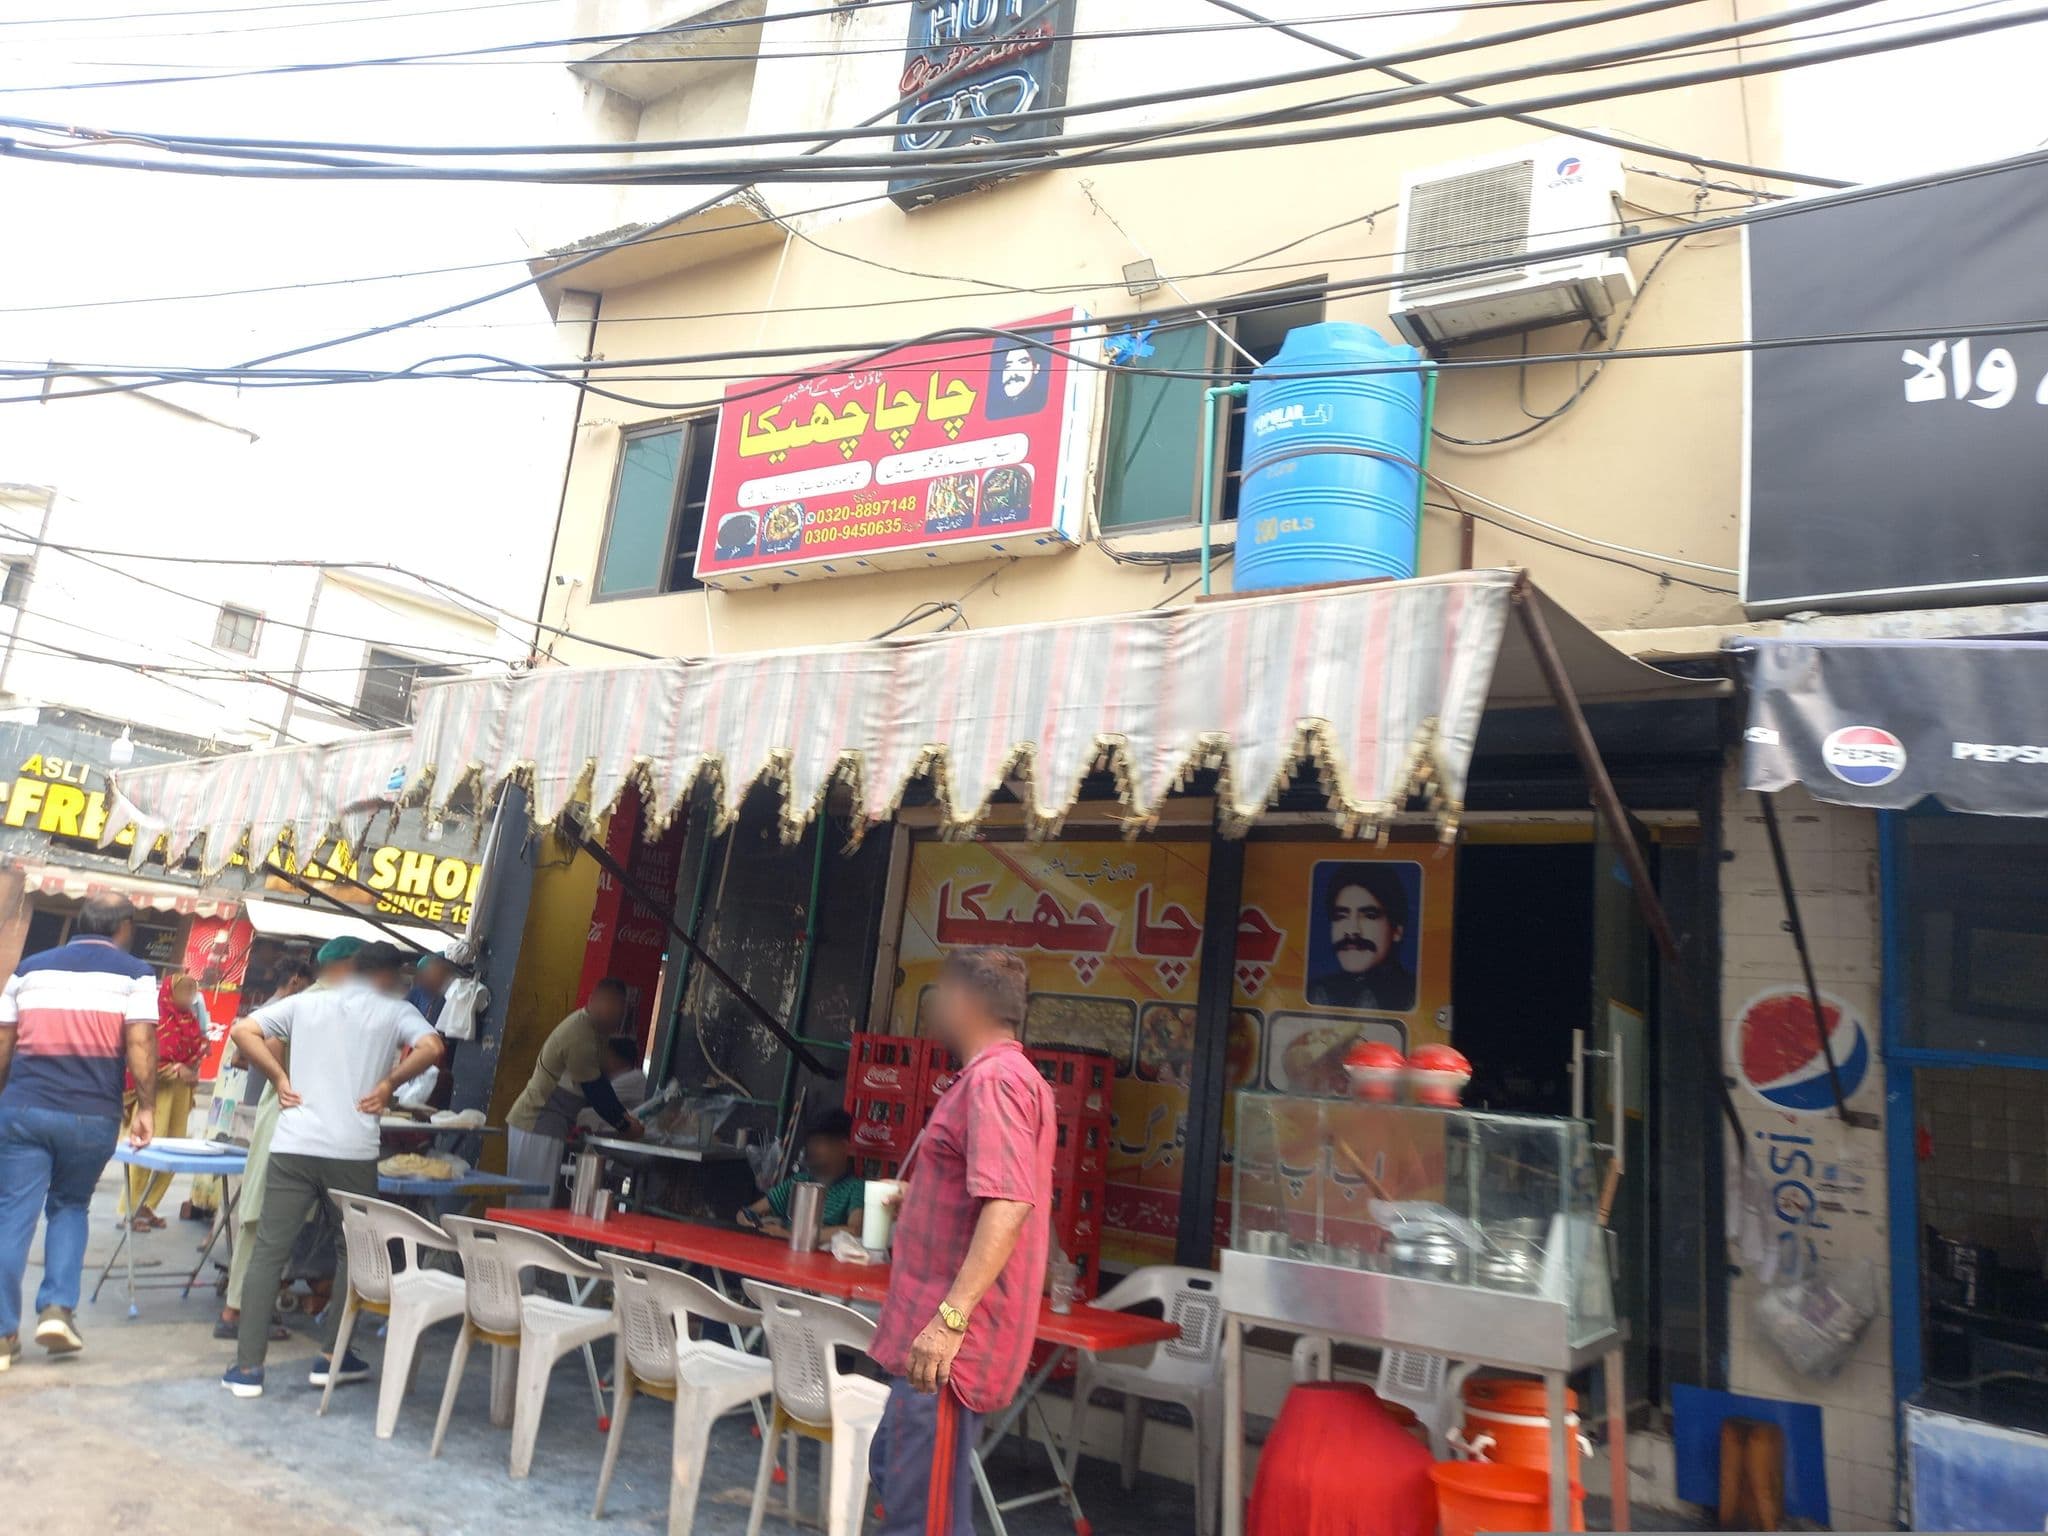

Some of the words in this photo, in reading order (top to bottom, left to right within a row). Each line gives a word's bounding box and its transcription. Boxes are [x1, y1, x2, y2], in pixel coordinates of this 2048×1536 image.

[1901, 338, 2017, 409] والا
[816, 496, 916, 525] 0320-8897148
[805, 518, 901, 544] 0300-9450635
[1833, 747, 1898, 764] PEPSI
[1952, 742, 2048, 764] PEPSI
[20, 753, 90, 784] ASLI
[376, 892, 444, 920] SINCE
